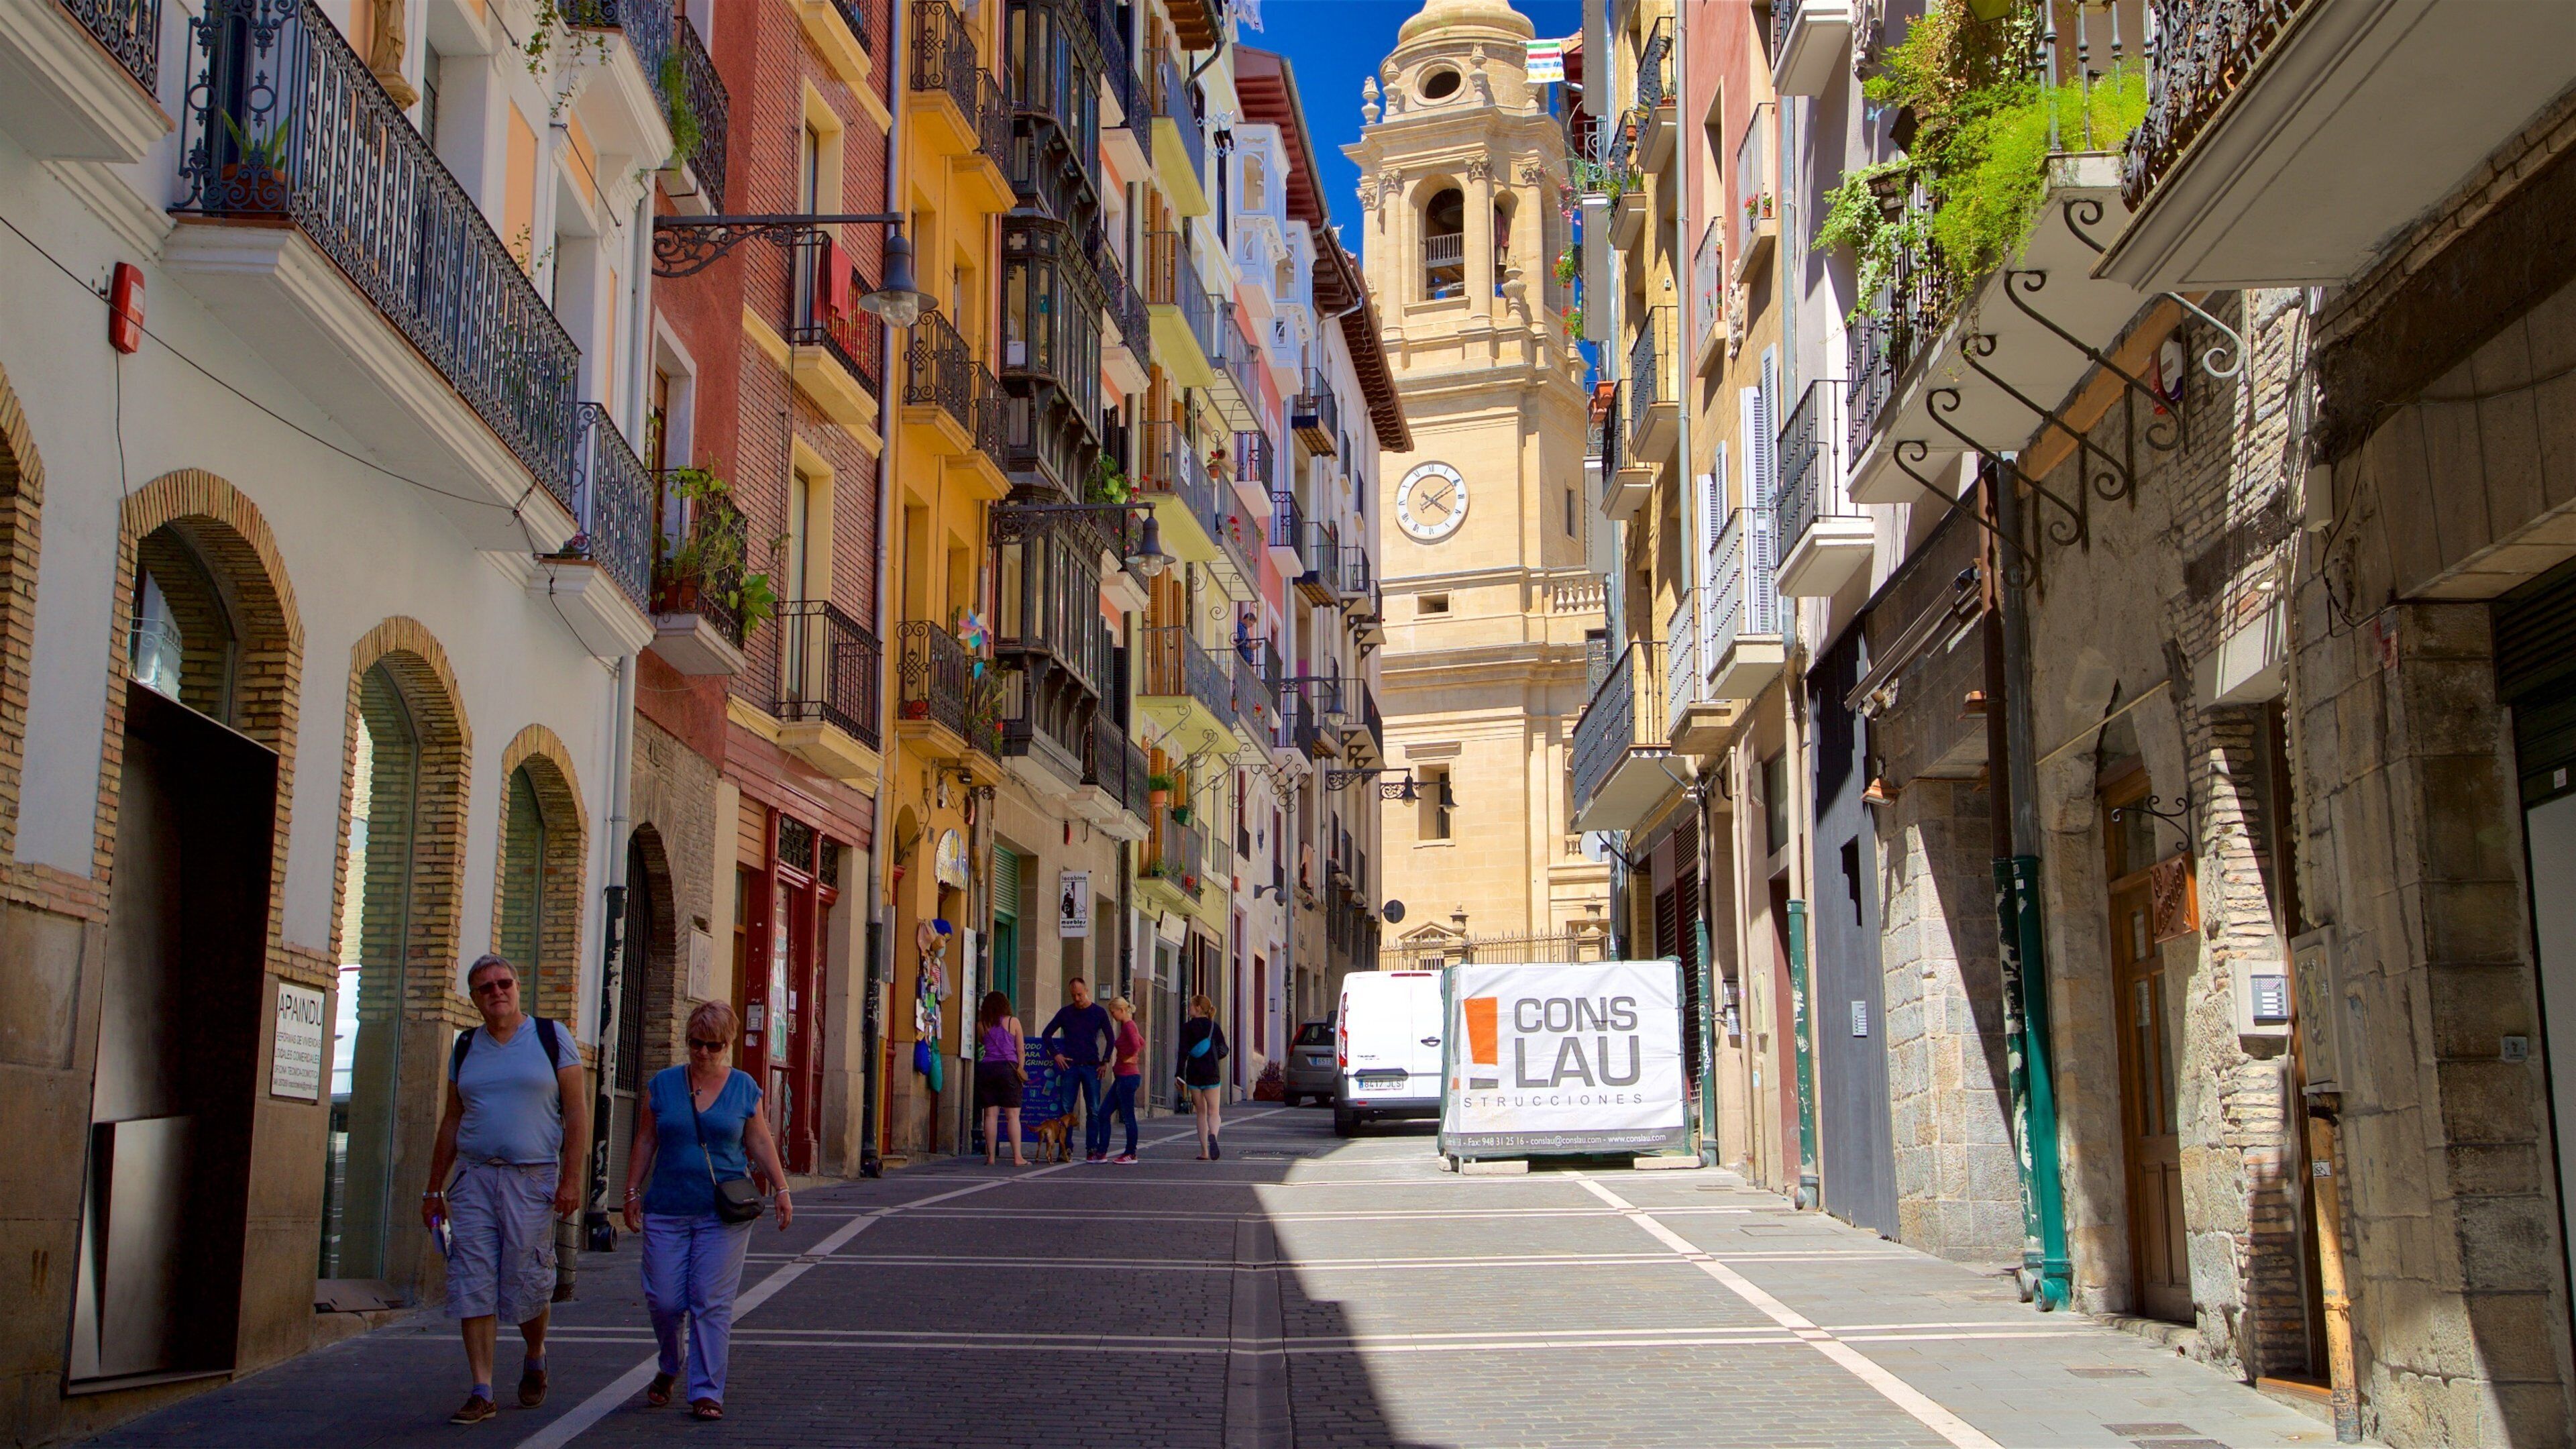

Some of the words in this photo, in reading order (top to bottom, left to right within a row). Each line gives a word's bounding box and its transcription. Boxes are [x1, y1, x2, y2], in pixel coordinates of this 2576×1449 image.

[278, 993, 324, 1026] APAINDU
[1514, 996, 1638, 1033] CONS
[1515, 1035, 1641, 1089] LAU
[1387, 1079, 1401, 1088] JLS
[1464, 1093, 1644, 1108] STRUCCIONES
[1468, 1137, 1481, 1146] Fax:
[1482, 1137, 1494, 1146] 948
[1496, 1137, 1503, 1146] 31
[1506, 1137, 1514, 1146] 25
[1517, 1136, 1524, 1146] 16
[1530, 1135, 1602, 1146] conslau@conslau.com
[1607, 1134, 1666, 1143] www.conslau.com
